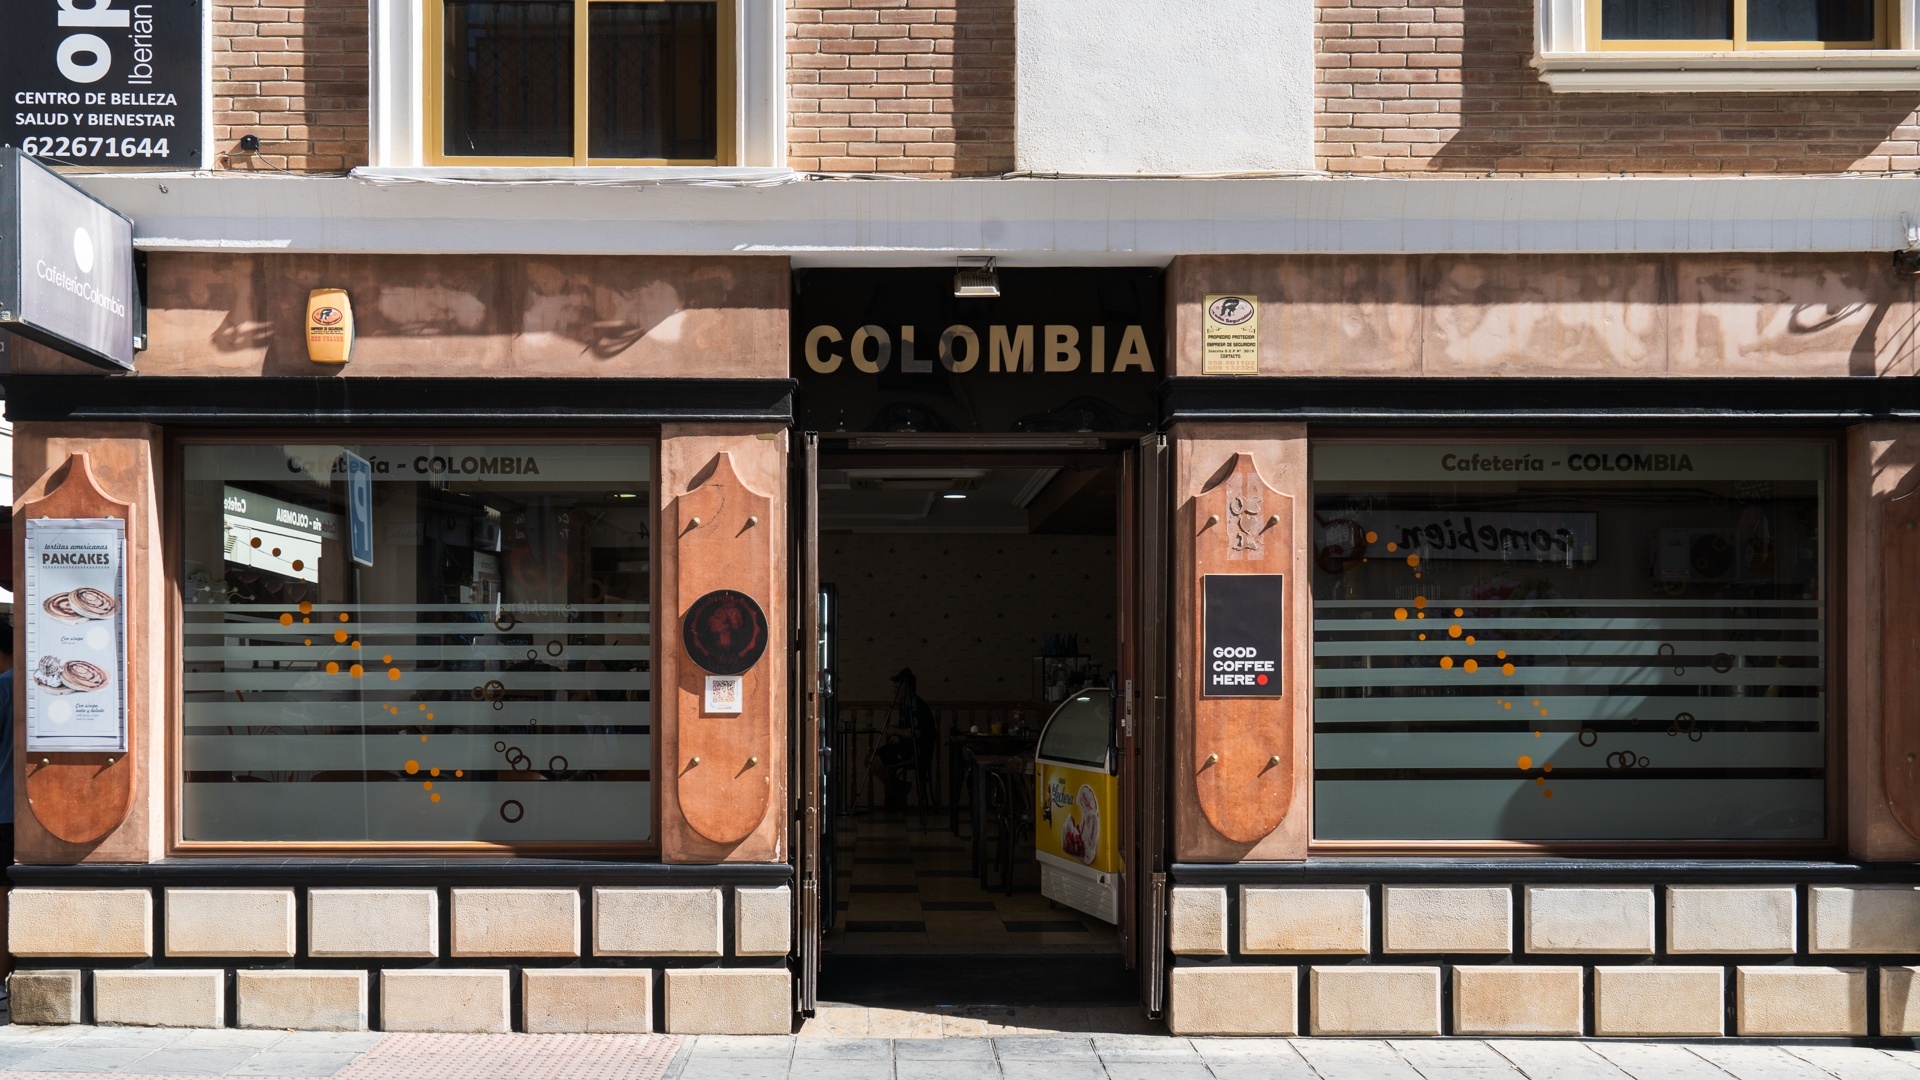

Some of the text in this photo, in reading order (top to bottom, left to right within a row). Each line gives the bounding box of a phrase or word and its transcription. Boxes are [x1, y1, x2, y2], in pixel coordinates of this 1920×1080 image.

[15, 92, 177, 106] CENTRO DE BELLEZA
[15, 113, 175, 127] SALUD Y BIENESTAR
[22, 136, 170, 158] 622671644
[805, 324, 1155, 374] COLOMBIA
[287, 455, 390, 474] Cafetería
[413, 455, 540, 475] COLOMBIA
[1441, 453, 1544, 472] Cafetería
[1567, 453, 1694, 472] COLOMBIA
[42, 553, 110, 565] PANCAKES
[1212, 646, 1257, 658] GOOD
[1212, 660, 1275, 672] COFFEE
[1212, 674, 1256, 685] HERE
